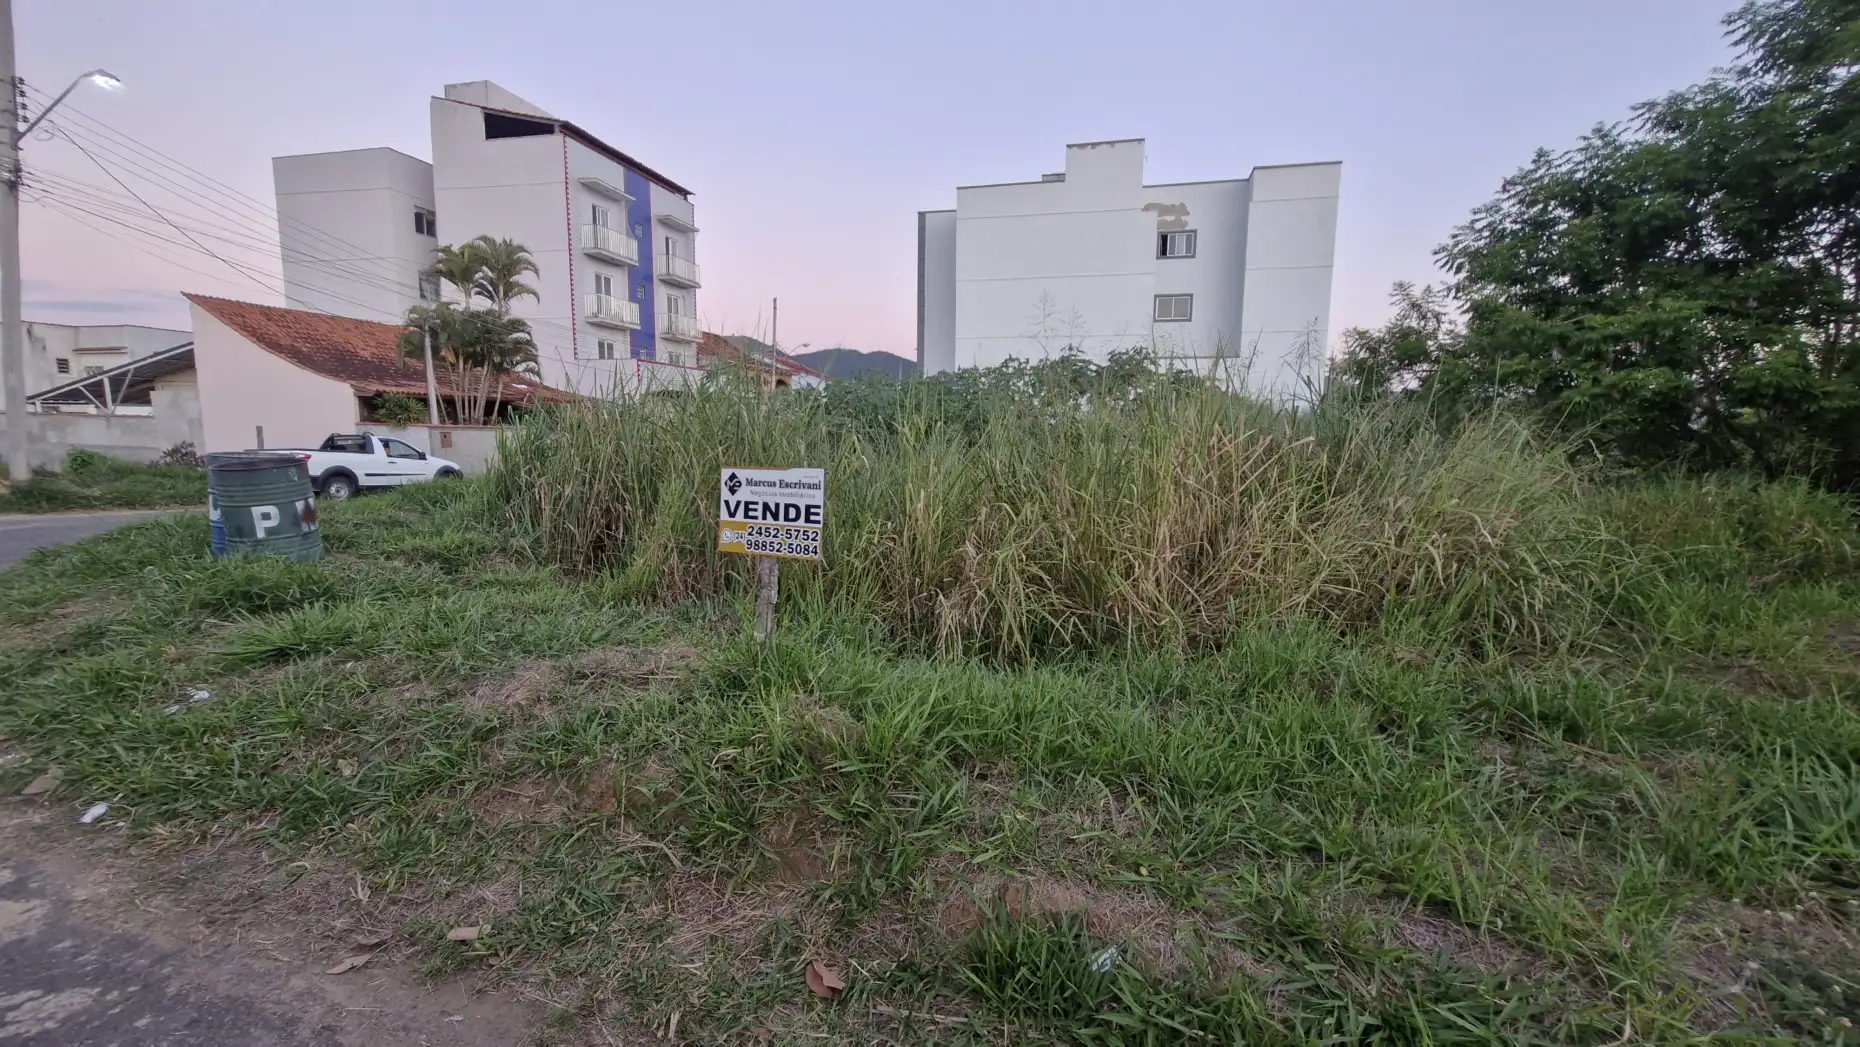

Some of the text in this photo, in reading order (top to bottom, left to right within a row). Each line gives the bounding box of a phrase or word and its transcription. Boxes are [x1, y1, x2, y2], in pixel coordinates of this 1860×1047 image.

[745, 477, 821, 490] Marcus Escrivani
[723, 499, 822, 525] VENDE
[251, 505, 280, 539] P
[747, 525, 819, 542] 2452-5752
[746, 539, 818, 556] 98852-5084
